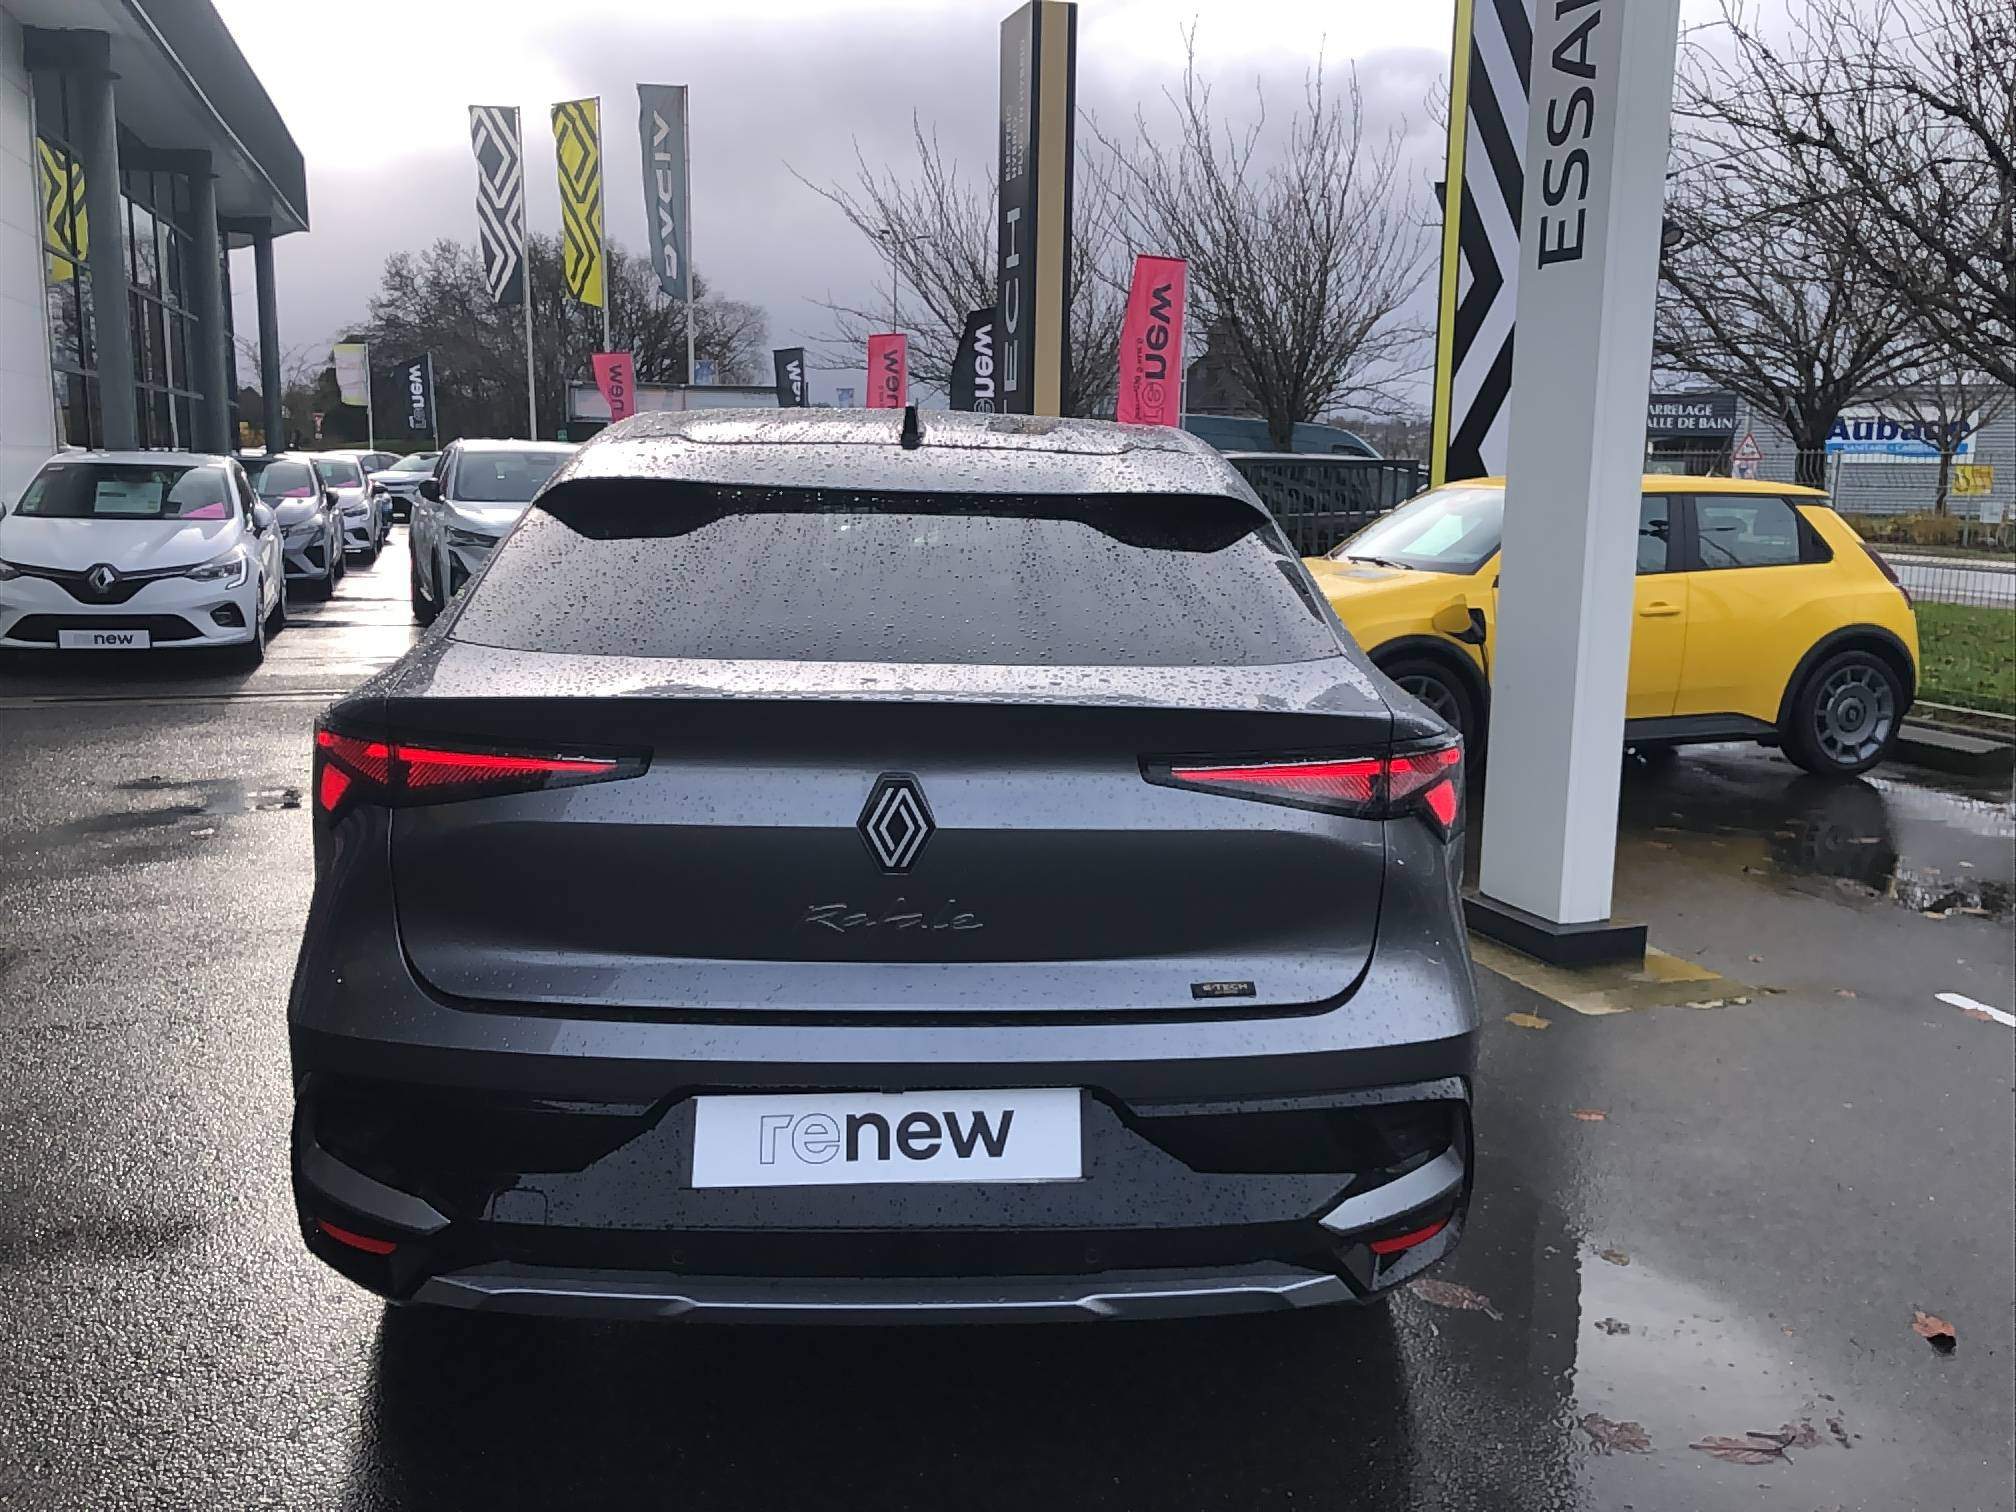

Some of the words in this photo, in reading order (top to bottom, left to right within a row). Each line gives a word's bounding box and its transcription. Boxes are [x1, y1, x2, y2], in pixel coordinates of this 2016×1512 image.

[1004, 207, 1021, 414] ECH
[1677, 417, 1696, 429] DE
[1699, 417, 1733, 429] BAIN
[760, 1110, 1014, 1164] renew
